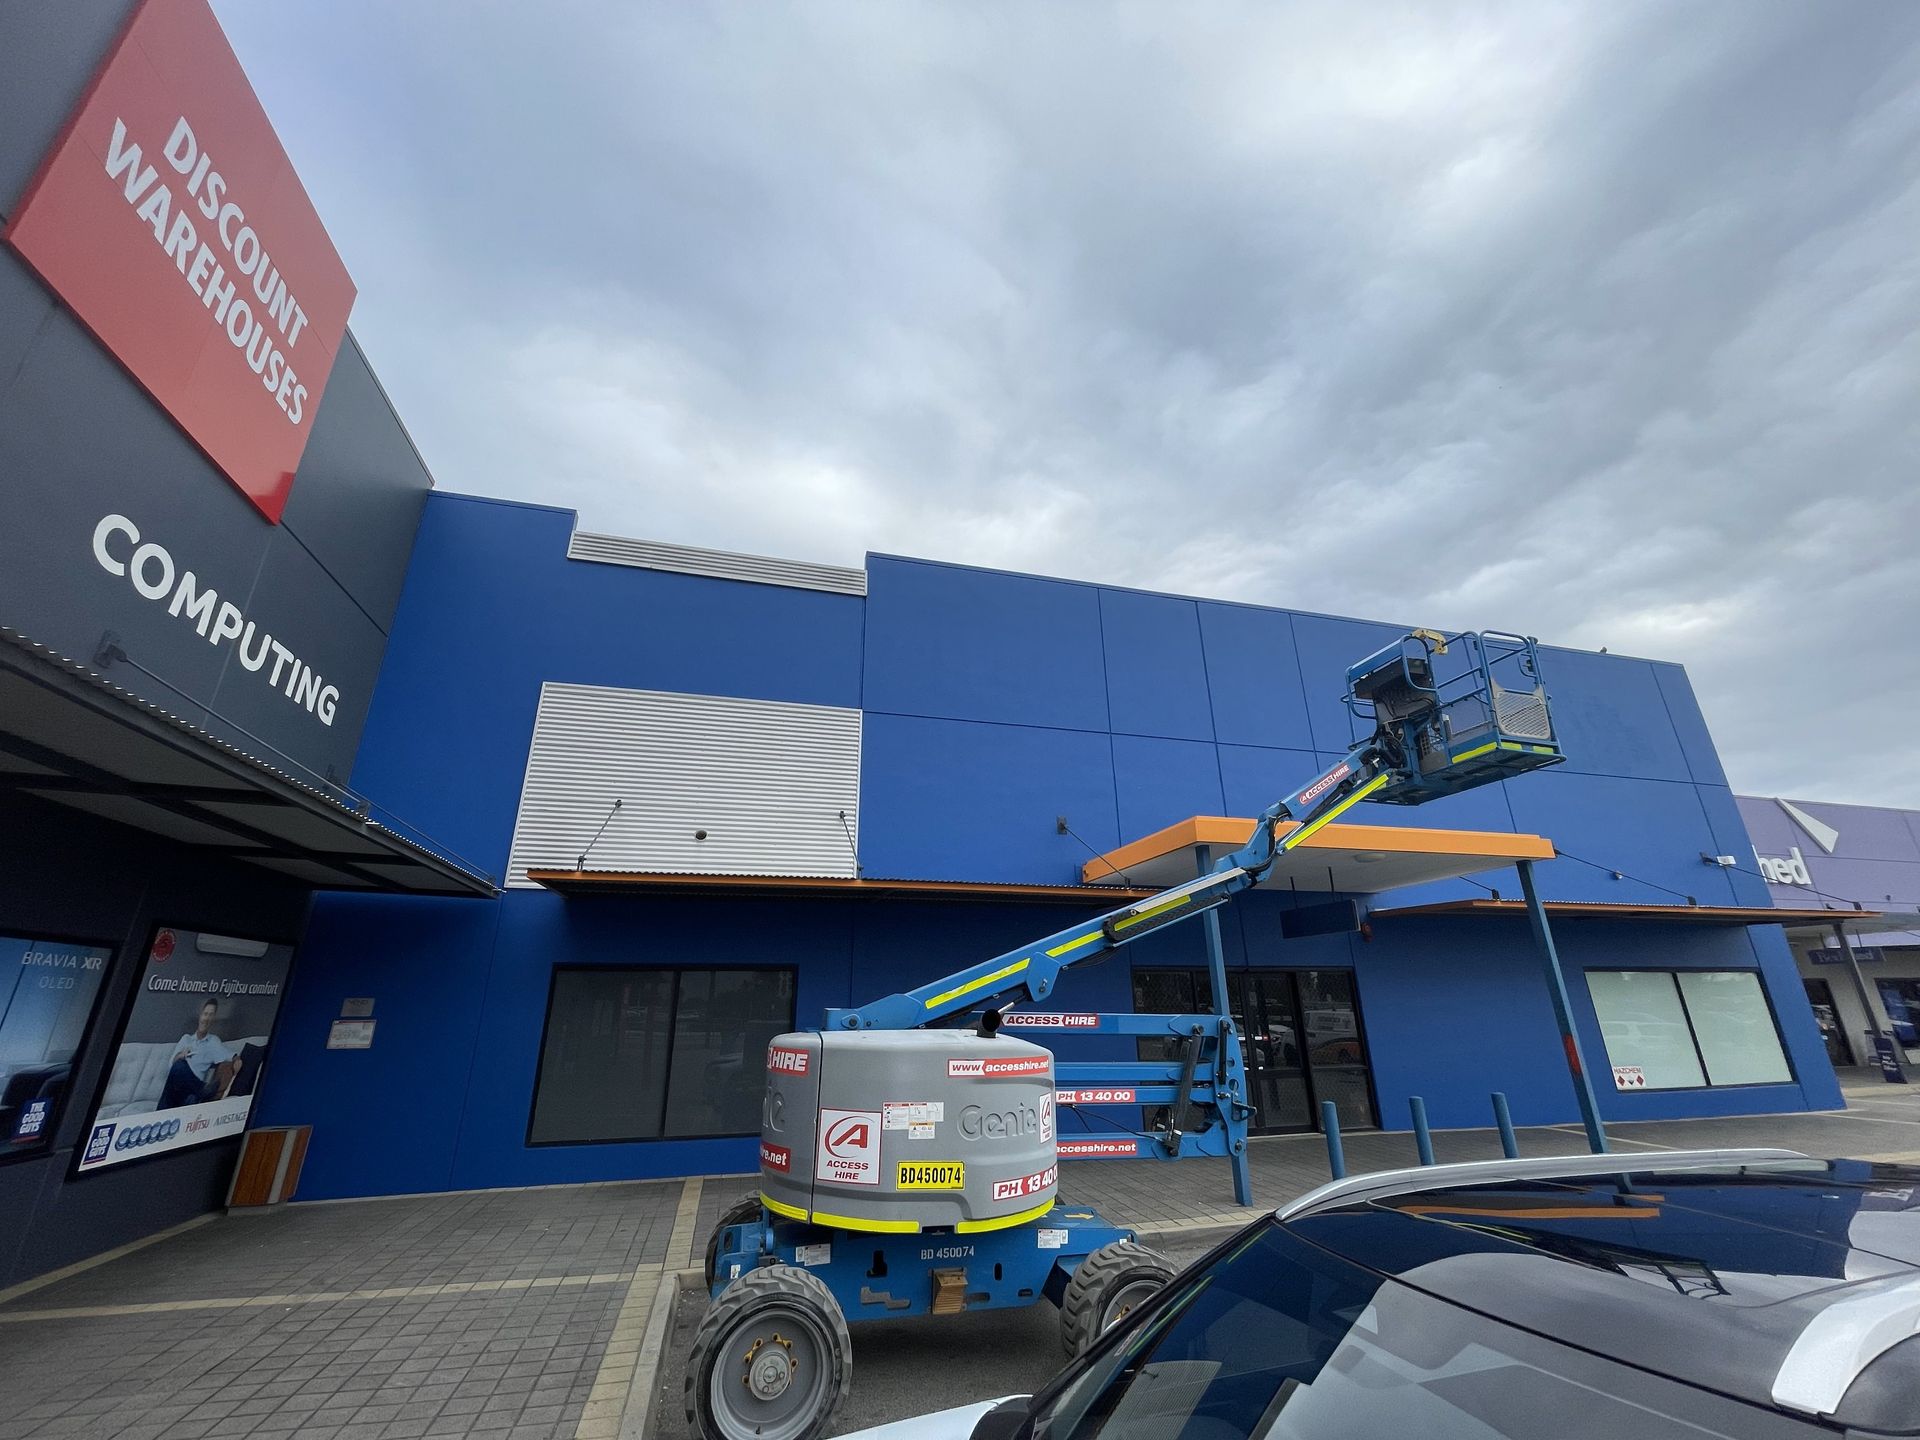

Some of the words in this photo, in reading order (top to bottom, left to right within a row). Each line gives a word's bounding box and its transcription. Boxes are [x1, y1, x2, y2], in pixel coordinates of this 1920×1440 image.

[163, 116, 308, 348] DISCOUNT
[103, 117, 308, 425] WAREHOUSES
[92, 513, 340, 726] COMPUTING
[1307, 775, 1334, 799] ACCESS
[1333, 764, 1350, 780] HIRE
[21, 951, 77, 969] BRAVIA
[80, 956, 102, 970] XR
[39, 975, 75, 990] OLED
[147, 974, 178, 992] Come
[178, 975, 208, 993] home
[208, 979, 219, 993] to
[219, 978, 248, 997] Fujitsu
[248, 980, 279, 995] comfort
[1006, 1015, 1060, 1025] ACCESS
[1064, 1015, 1097, 1026] HIRE
[771, 1050, 808, 1072] HIRE
[951, 1062, 982, 1073] www
[984, 1059, 1049, 1073] accesshire.net
[1058, 1092, 1073, 1101] PH
[1080, 1091, 1094, 1101] 13
[1094, 1091, 1112, 1101] 40
[1113, 1091, 1131, 1101] 00
[184, 1118, 210, 1134] FUJITSU
[956, 1102, 1038, 1142] Genie
[826, 1160, 869, 1171] ACCESS
[834, 1170, 860, 1180] HIRE
[900, 1167, 961, 1184] BD450074
[997, 1181, 1020, 1197] PH
[1027, 1174, 1041, 1192] 13
[1041, 1168, 1053, 1187] 40
[920, 1248, 934, 1260] BD
[936, 1245, 975, 1259] 450074
